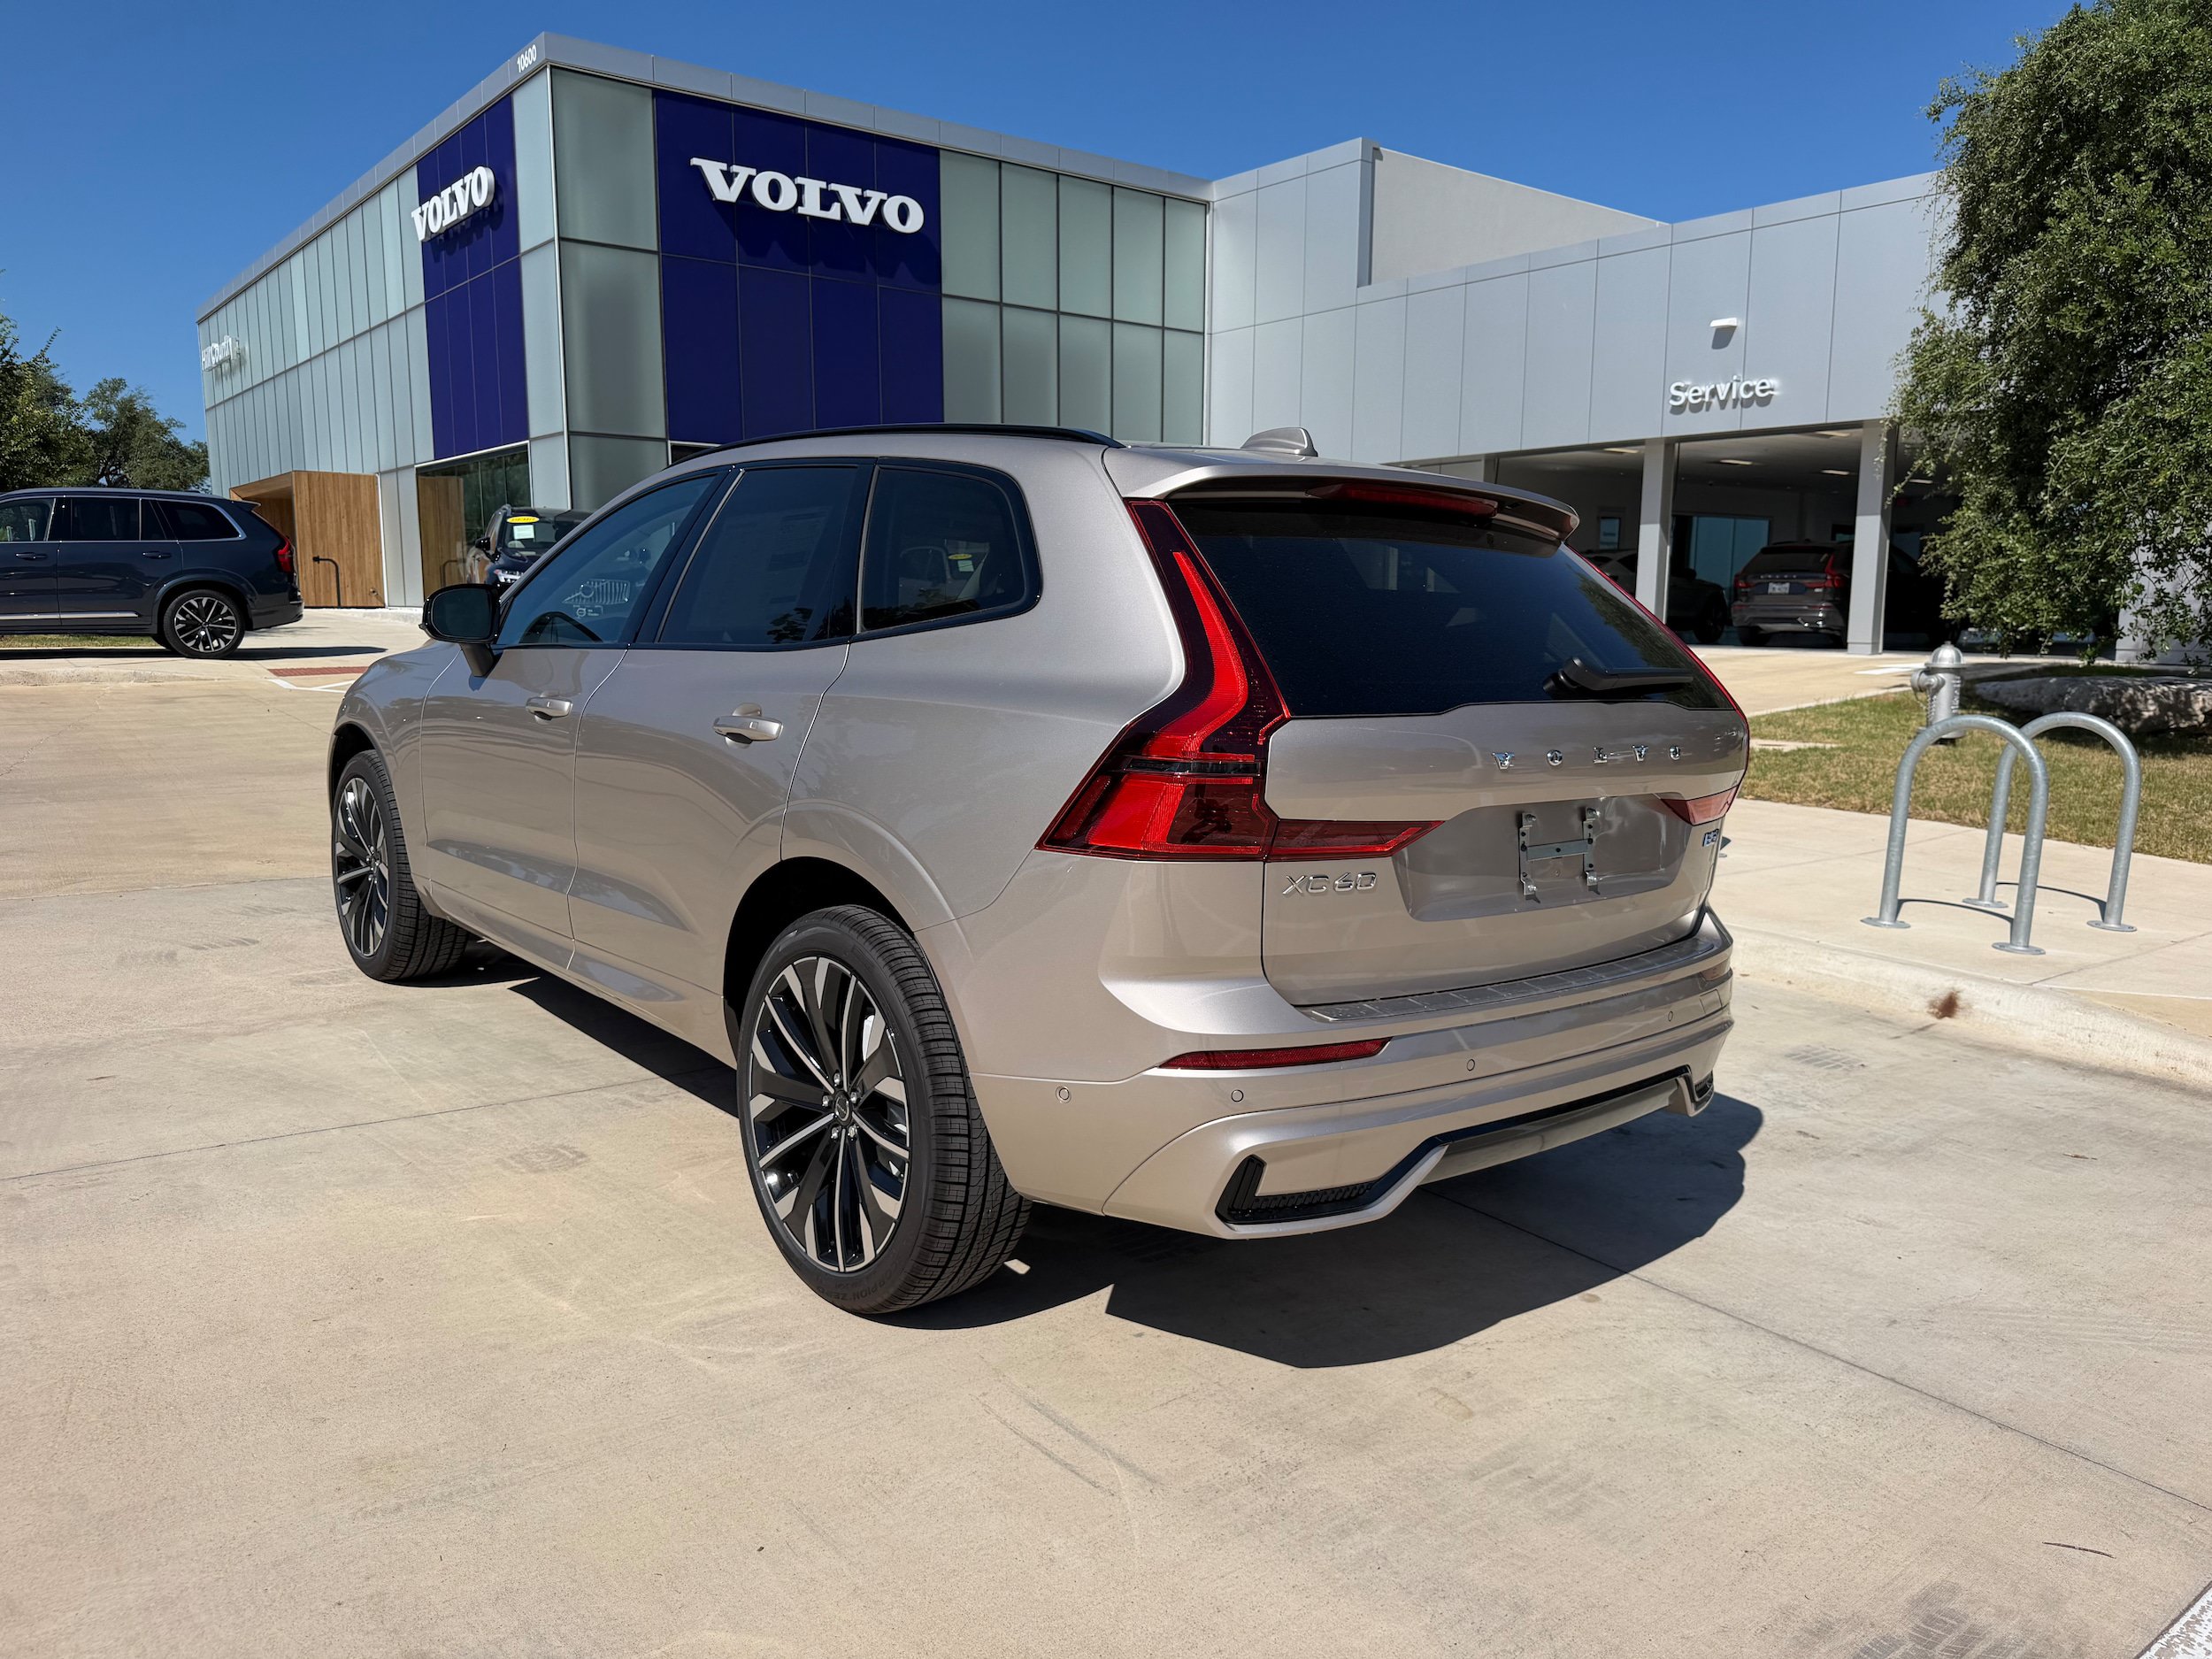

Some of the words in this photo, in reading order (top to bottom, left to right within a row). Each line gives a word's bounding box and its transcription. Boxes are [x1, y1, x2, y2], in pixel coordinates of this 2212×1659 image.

[517, 44, 537, 73] 10600
[411, 165, 495, 242] VOLVO
[690, 157, 924, 234] VOLVO
[1669, 375, 1772, 405] Service
[1492, 745, 1681, 770] VOLVO
[1282, 872, 1376, 895] XC60
